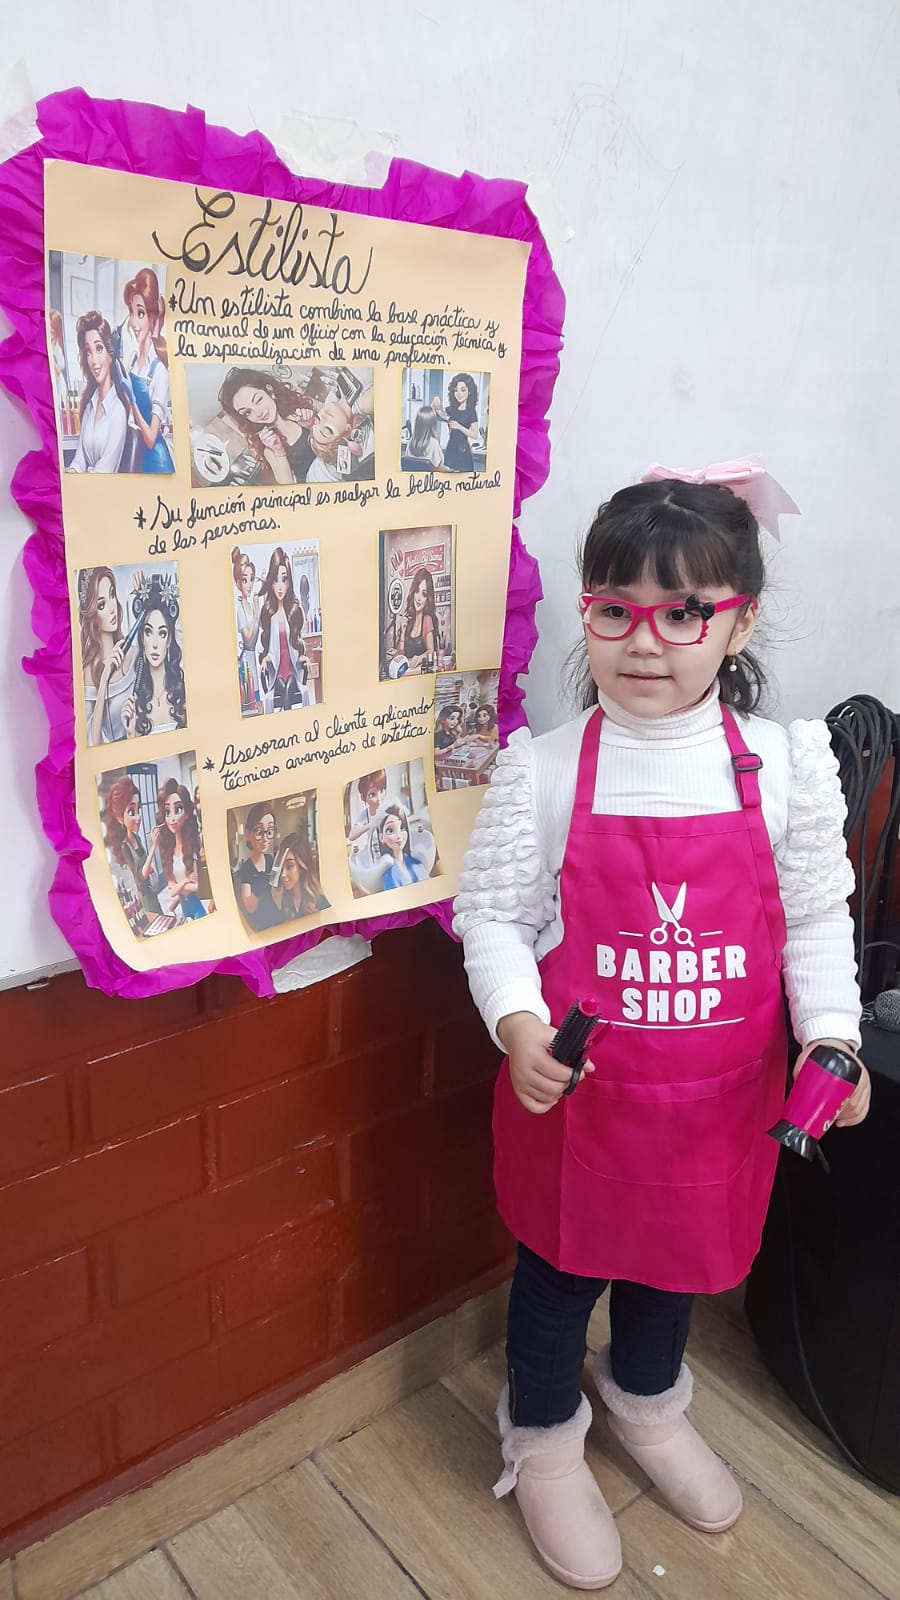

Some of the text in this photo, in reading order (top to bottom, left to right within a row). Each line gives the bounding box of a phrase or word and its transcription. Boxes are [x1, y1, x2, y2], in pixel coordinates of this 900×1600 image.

[152, 187, 373, 294] Estilista
[175, 278, 500, 338] Un estilista combina la base práctica y
[174, 317, 249, 340] manual
[253, 319, 269, 339] de
[272, 326, 294, 340] un
[341, 326, 366, 340] con
[371, 325, 386, 344] la
[389, 326, 448, 347] educación
[498, 342, 507, 359] y
[174, 335, 197, 358] la
[328, 340, 345, 361] de
[352, 347, 380, 361] una
[384, 345, 452, 369] profesión.
[150, 471, 501, 530] Su función principal es realzar la belleza natural
[148, 517, 281, 555] de las personas.
[219, 696, 435, 773] Asesoran al cliente aplicando
[221, 720, 431, 791] técnicas avanzadas de estética.
[596, 943, 748, 984] BARBER
[621, 987, 722, 1023] SHOP
